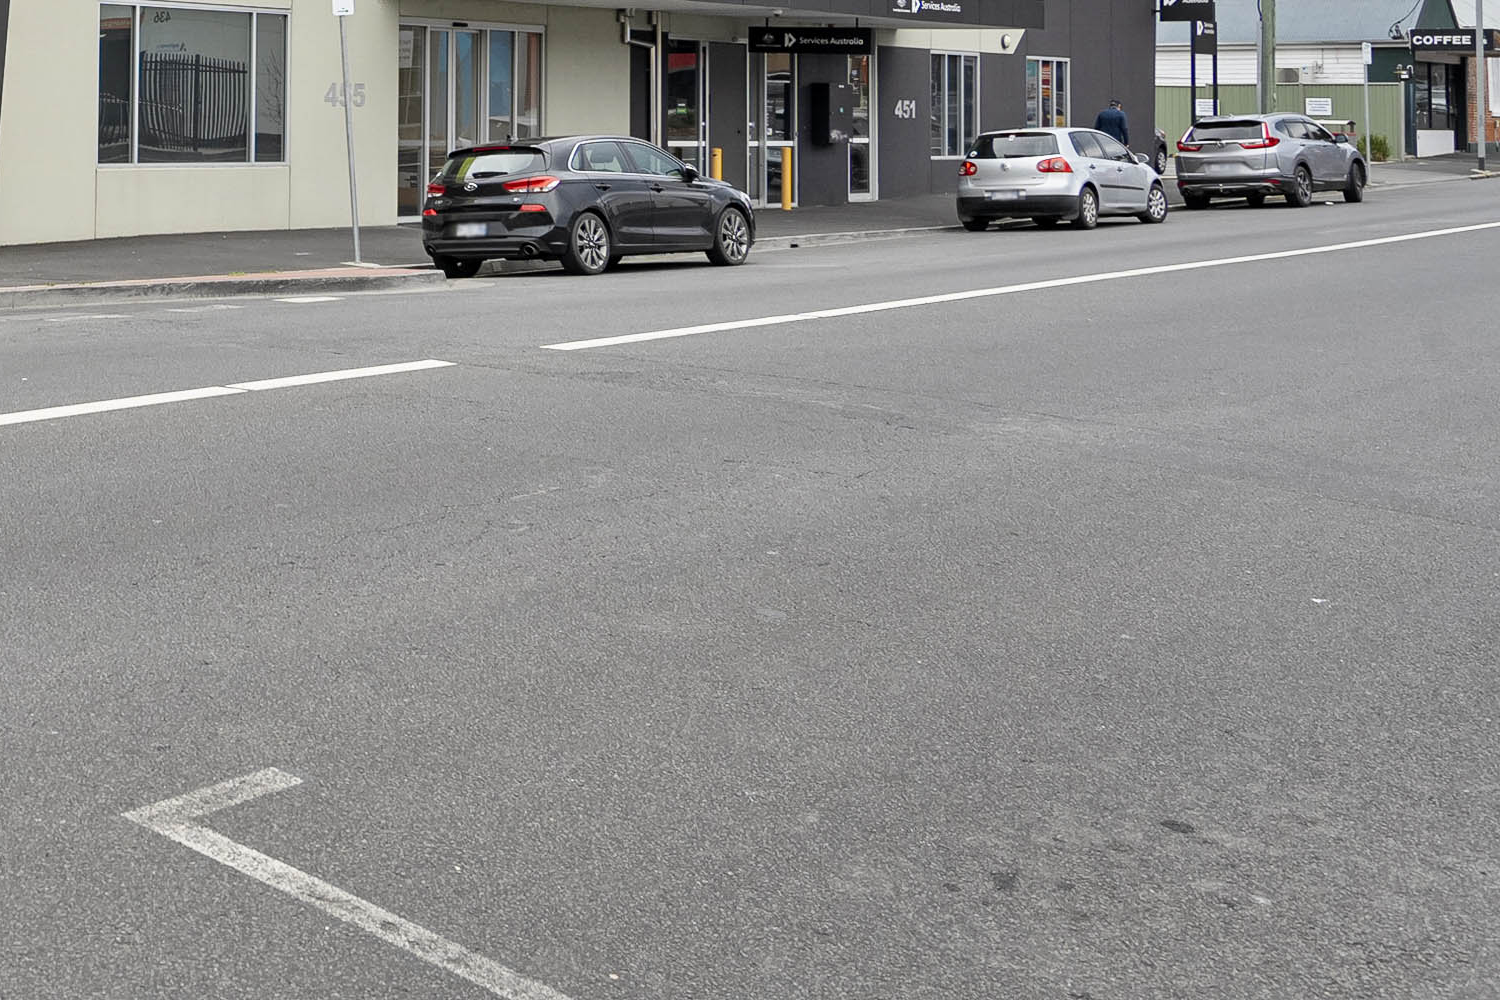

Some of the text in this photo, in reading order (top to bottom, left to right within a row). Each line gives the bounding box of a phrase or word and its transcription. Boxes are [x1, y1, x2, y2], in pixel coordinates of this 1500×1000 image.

[921, 0, 961, 12] Services Australia
[799, 37, 864, 46] Services Australia
[1412, 35, 1472, 45] COFFEE
[895, 100, 916, 119] 451
